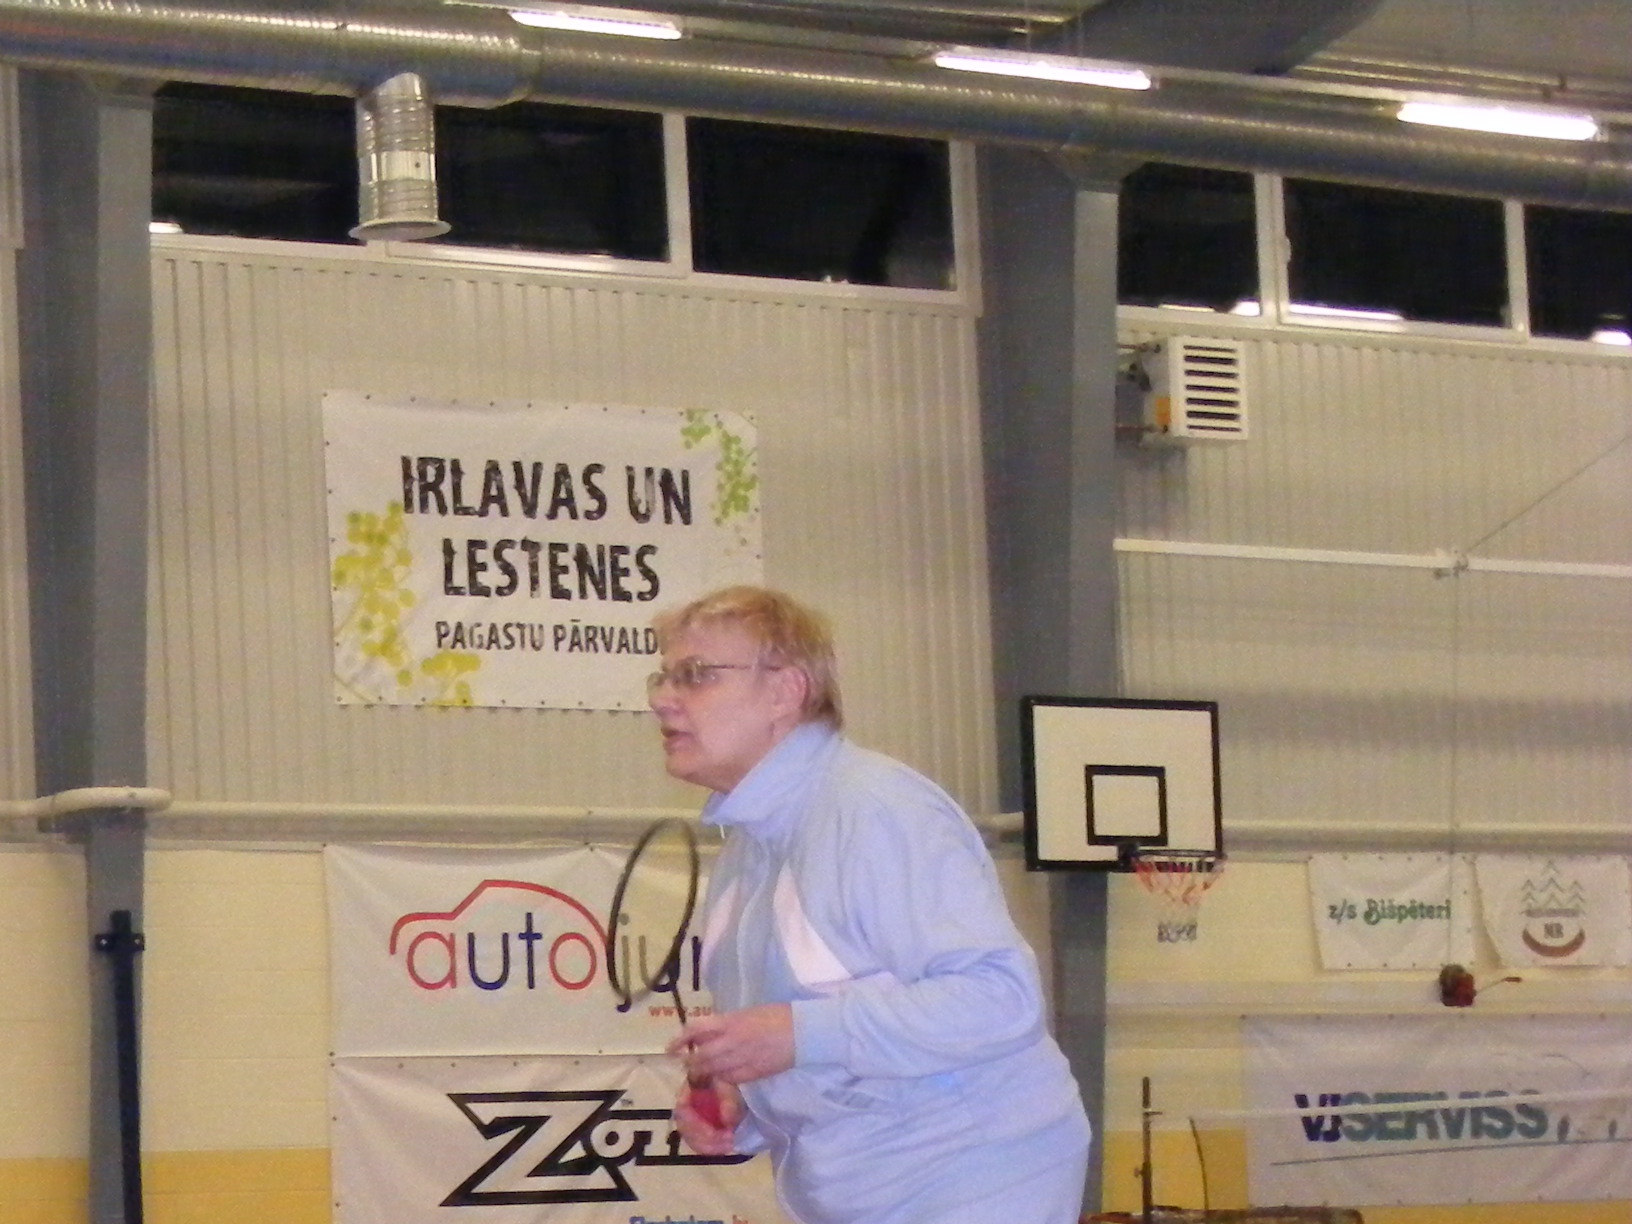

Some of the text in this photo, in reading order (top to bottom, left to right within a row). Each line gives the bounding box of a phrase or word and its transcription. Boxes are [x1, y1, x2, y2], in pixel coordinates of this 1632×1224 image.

[401, 455, 694, 526] IRLAVAS UN
[442, 537, 660, 603] LESTENES
[435, 619, 663, 655] PAGASTU PĀRVALD
